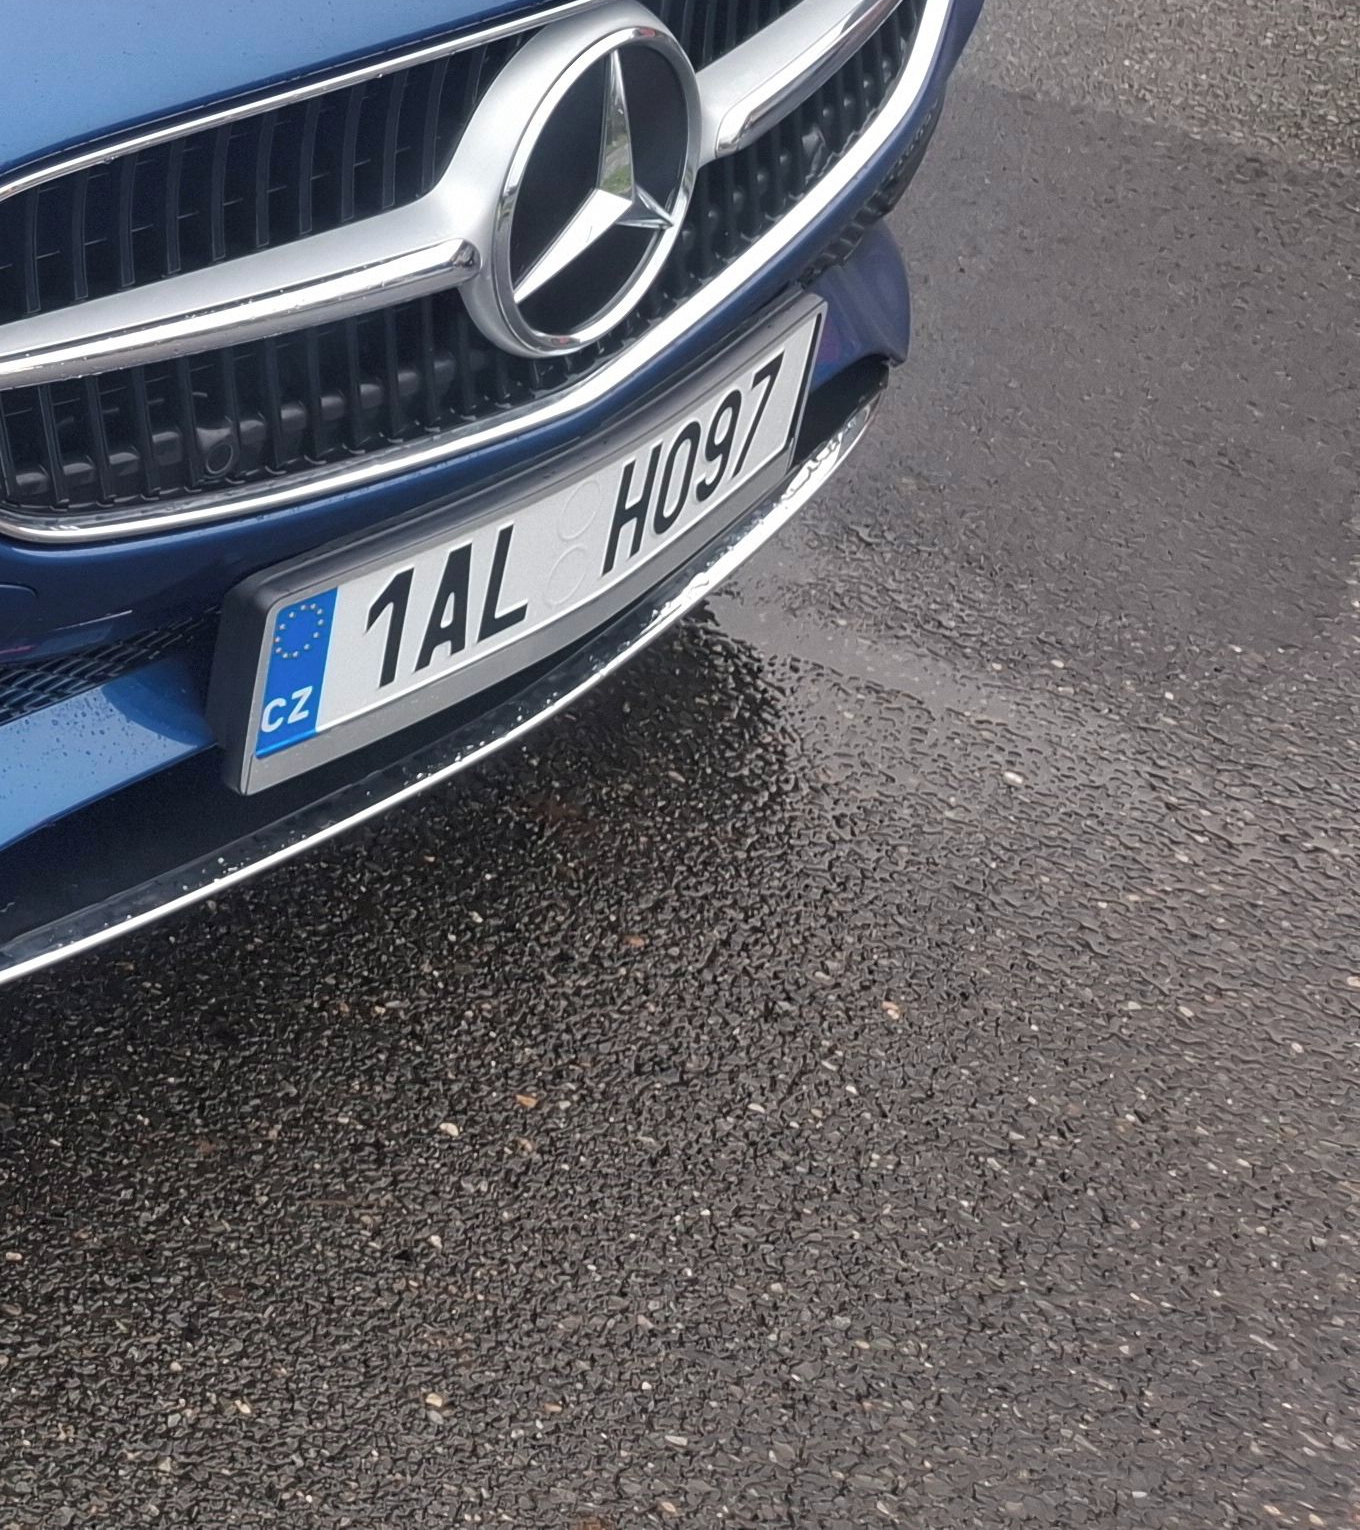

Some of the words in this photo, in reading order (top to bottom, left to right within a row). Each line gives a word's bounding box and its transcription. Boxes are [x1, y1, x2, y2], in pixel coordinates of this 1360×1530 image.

[365, 523, 529, 688] 1AL
[601, 350, 786, 577] H097
[260, 686, 311, 733] CZ
